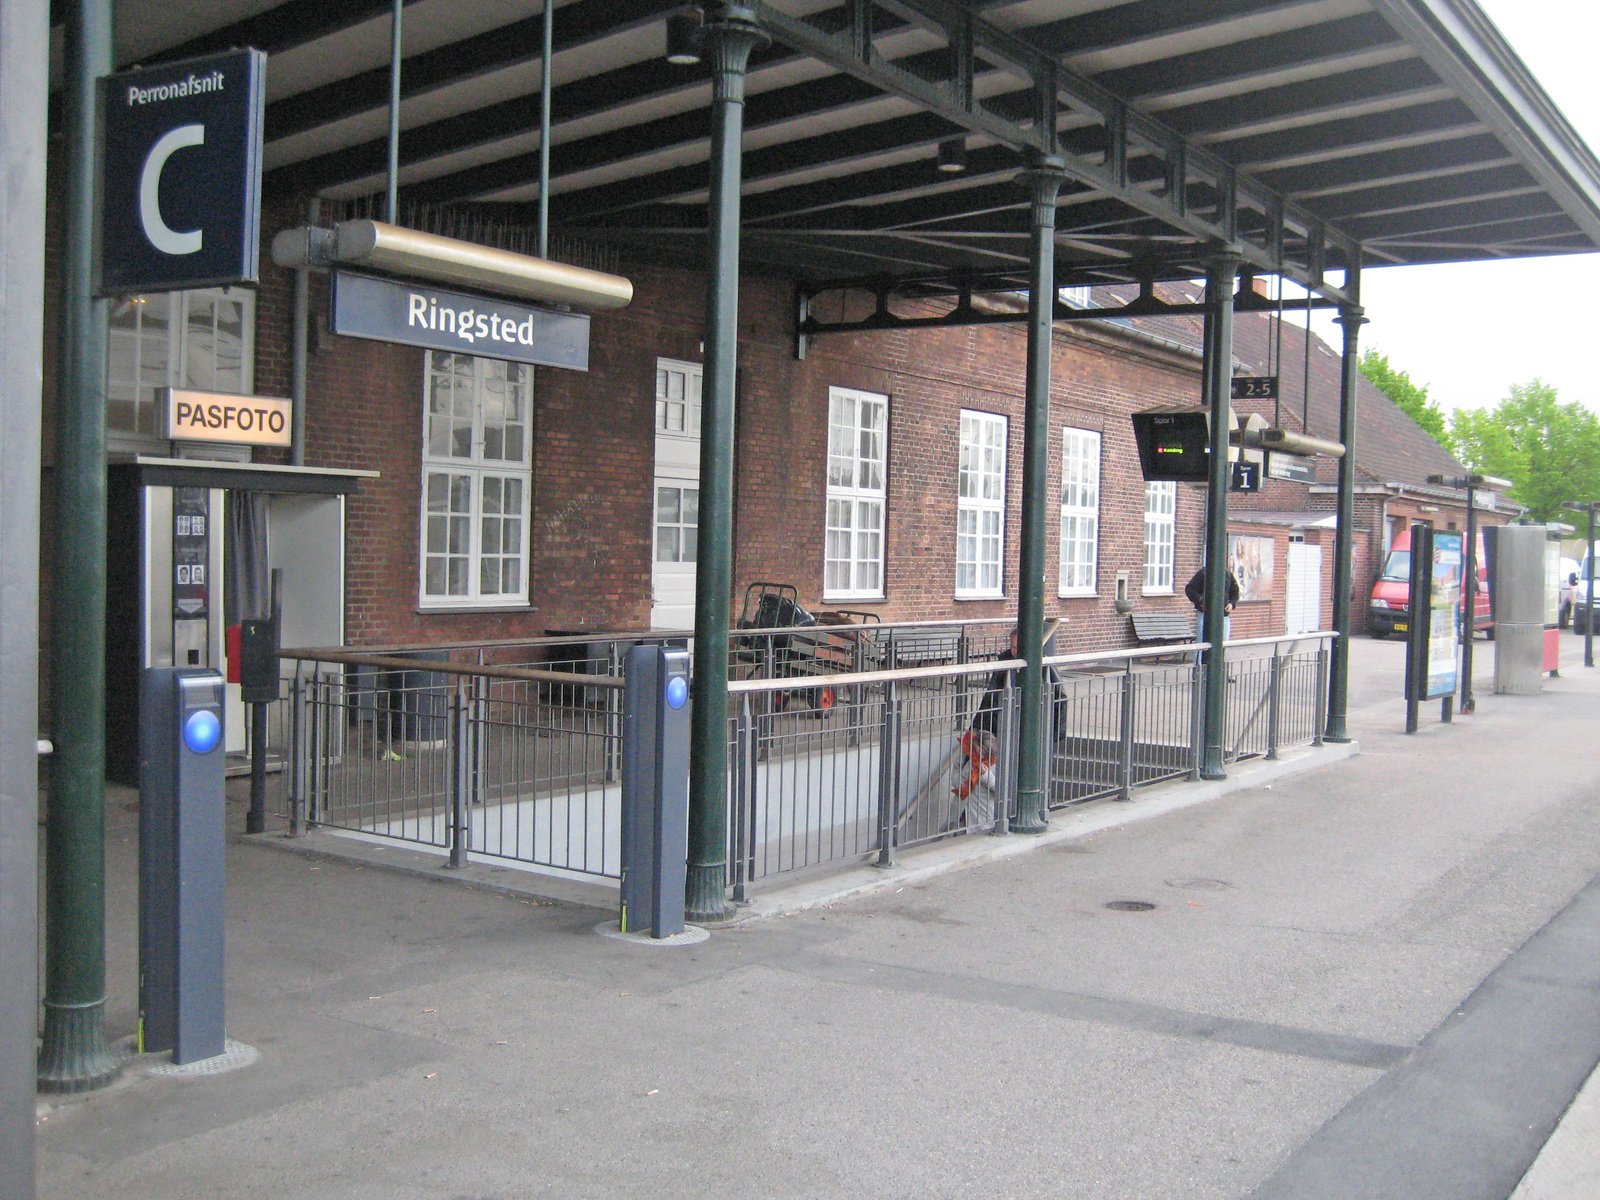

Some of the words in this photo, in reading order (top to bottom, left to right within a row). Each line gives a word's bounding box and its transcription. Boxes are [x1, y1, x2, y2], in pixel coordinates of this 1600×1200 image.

[128, 71, 225, 107] Perronafsnit
[139, 123, 205, 256] C
[408, 293, 534, 346] Ringsted
[176, 402, 286, 434] PASFOTO
[1239, 472, 1251, 489] 1
